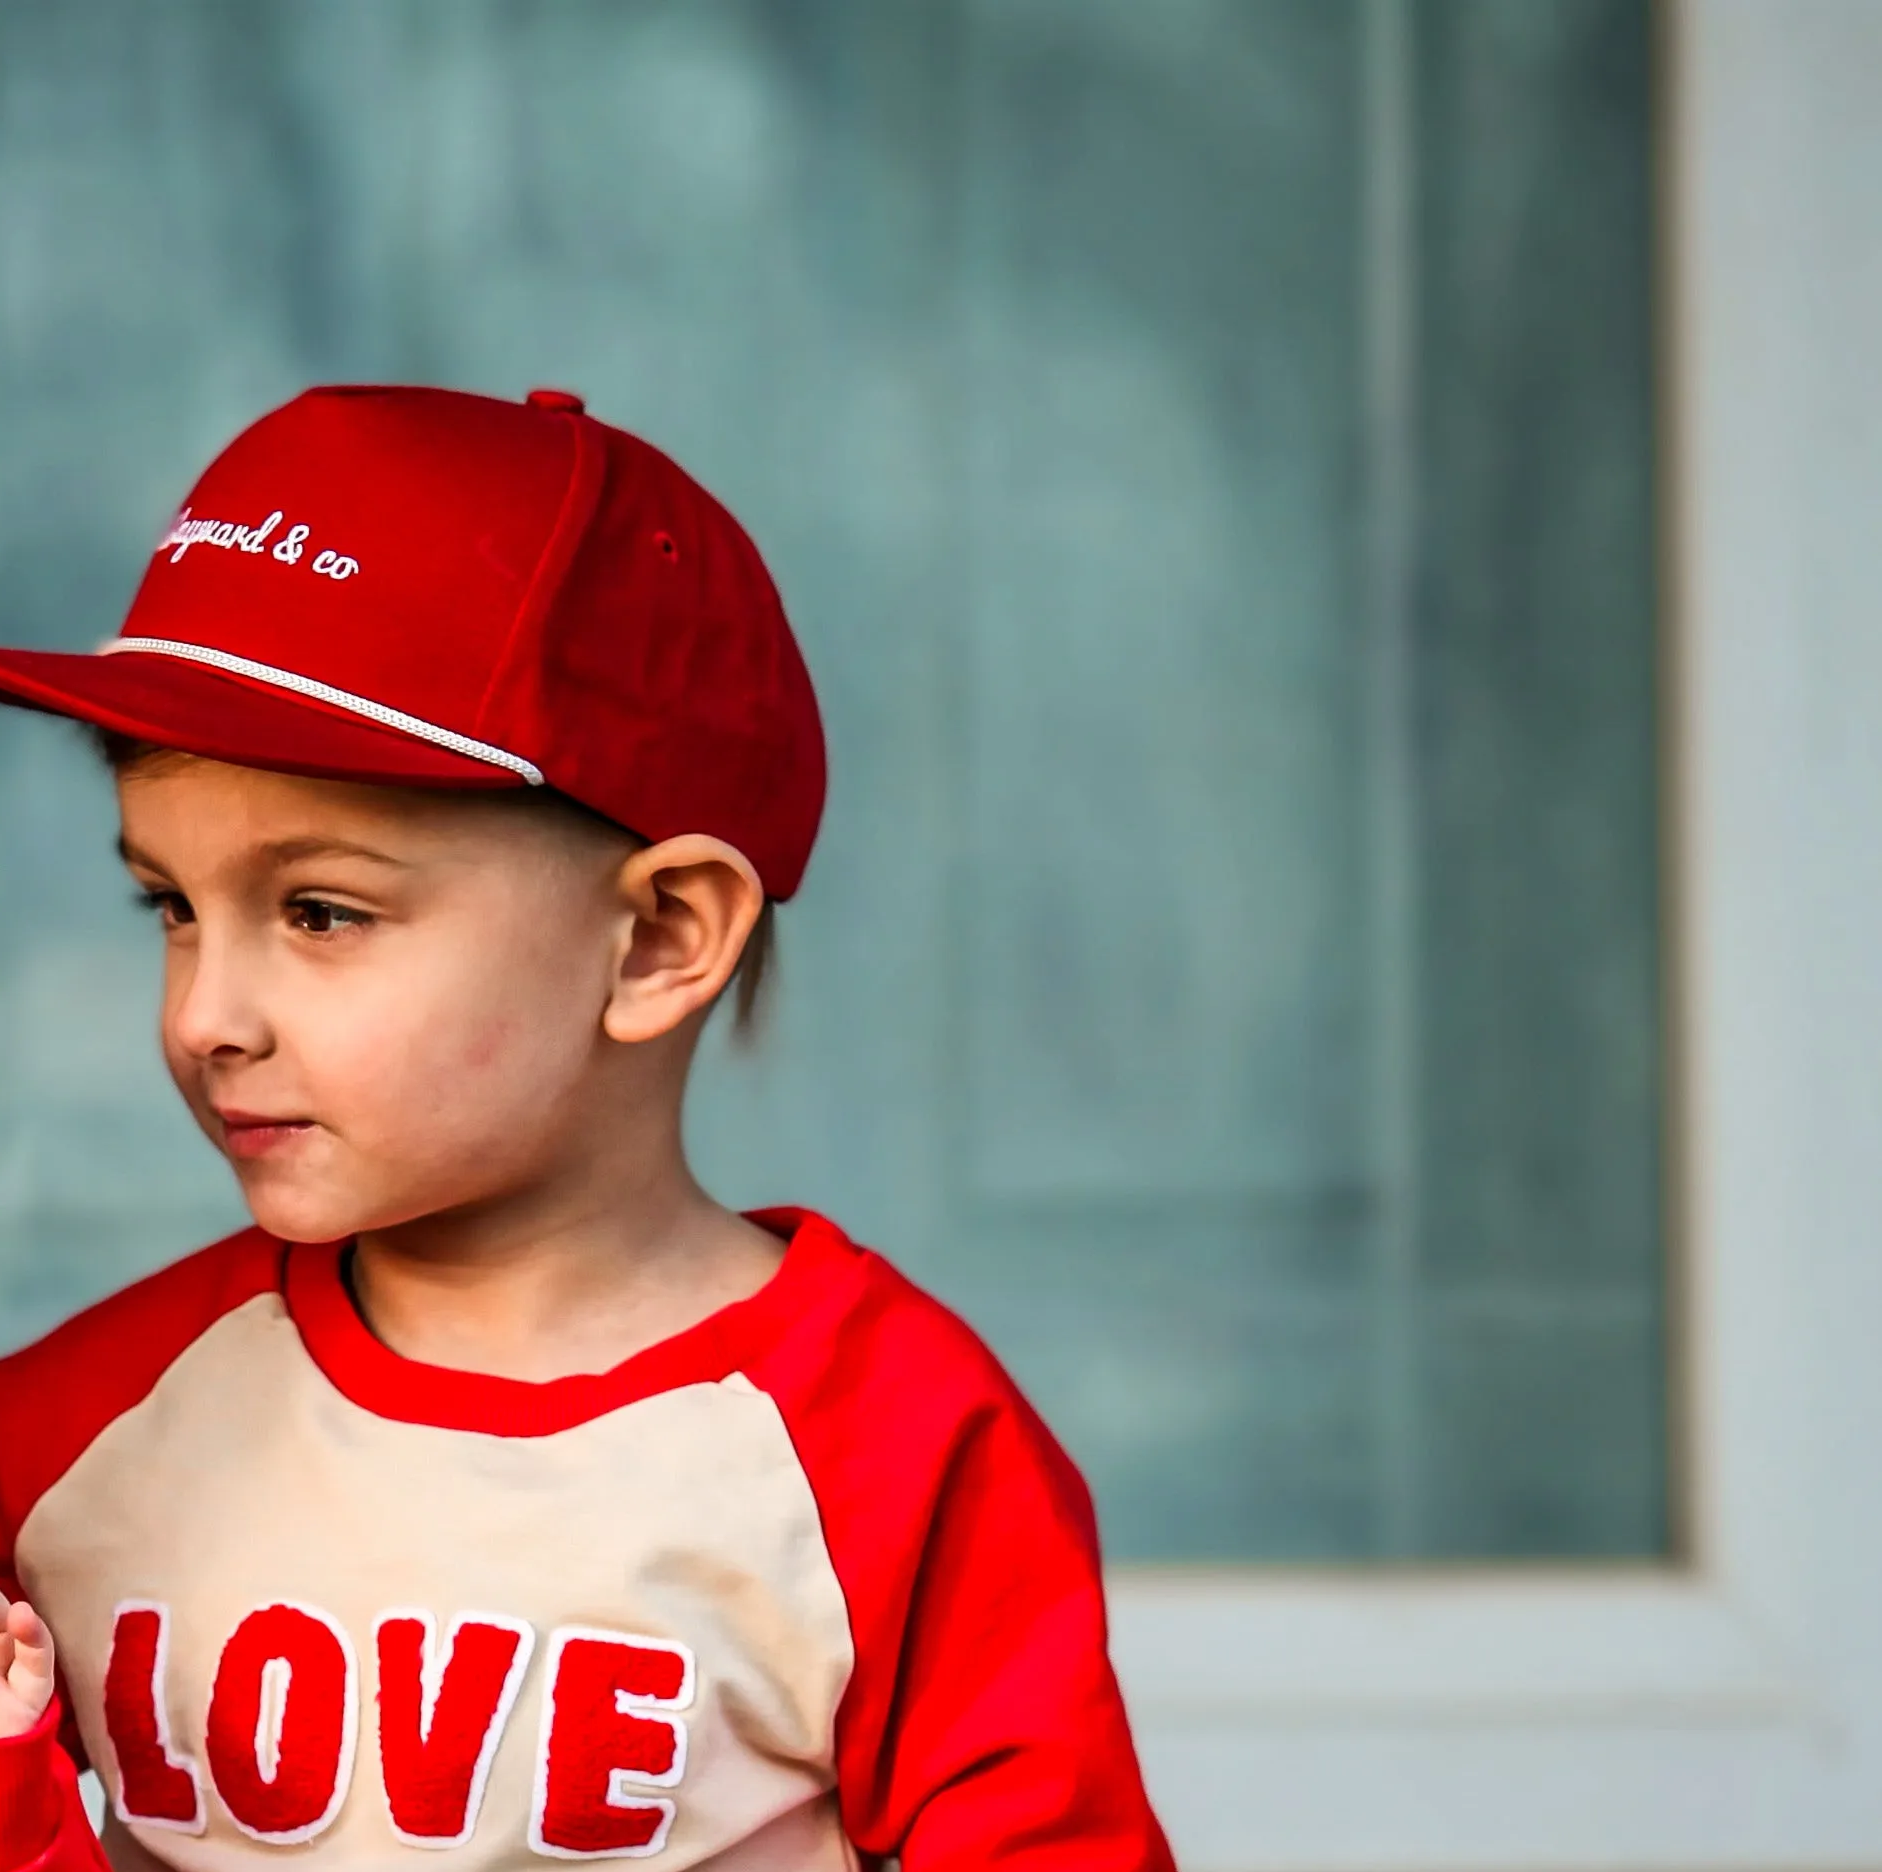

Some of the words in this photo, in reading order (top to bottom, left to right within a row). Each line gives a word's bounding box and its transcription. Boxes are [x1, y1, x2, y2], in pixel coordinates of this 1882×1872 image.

[273, 525, 309, 564] &
[313, 550, 359, 579] co
[105, 1600, 695, 1859] LOVE
